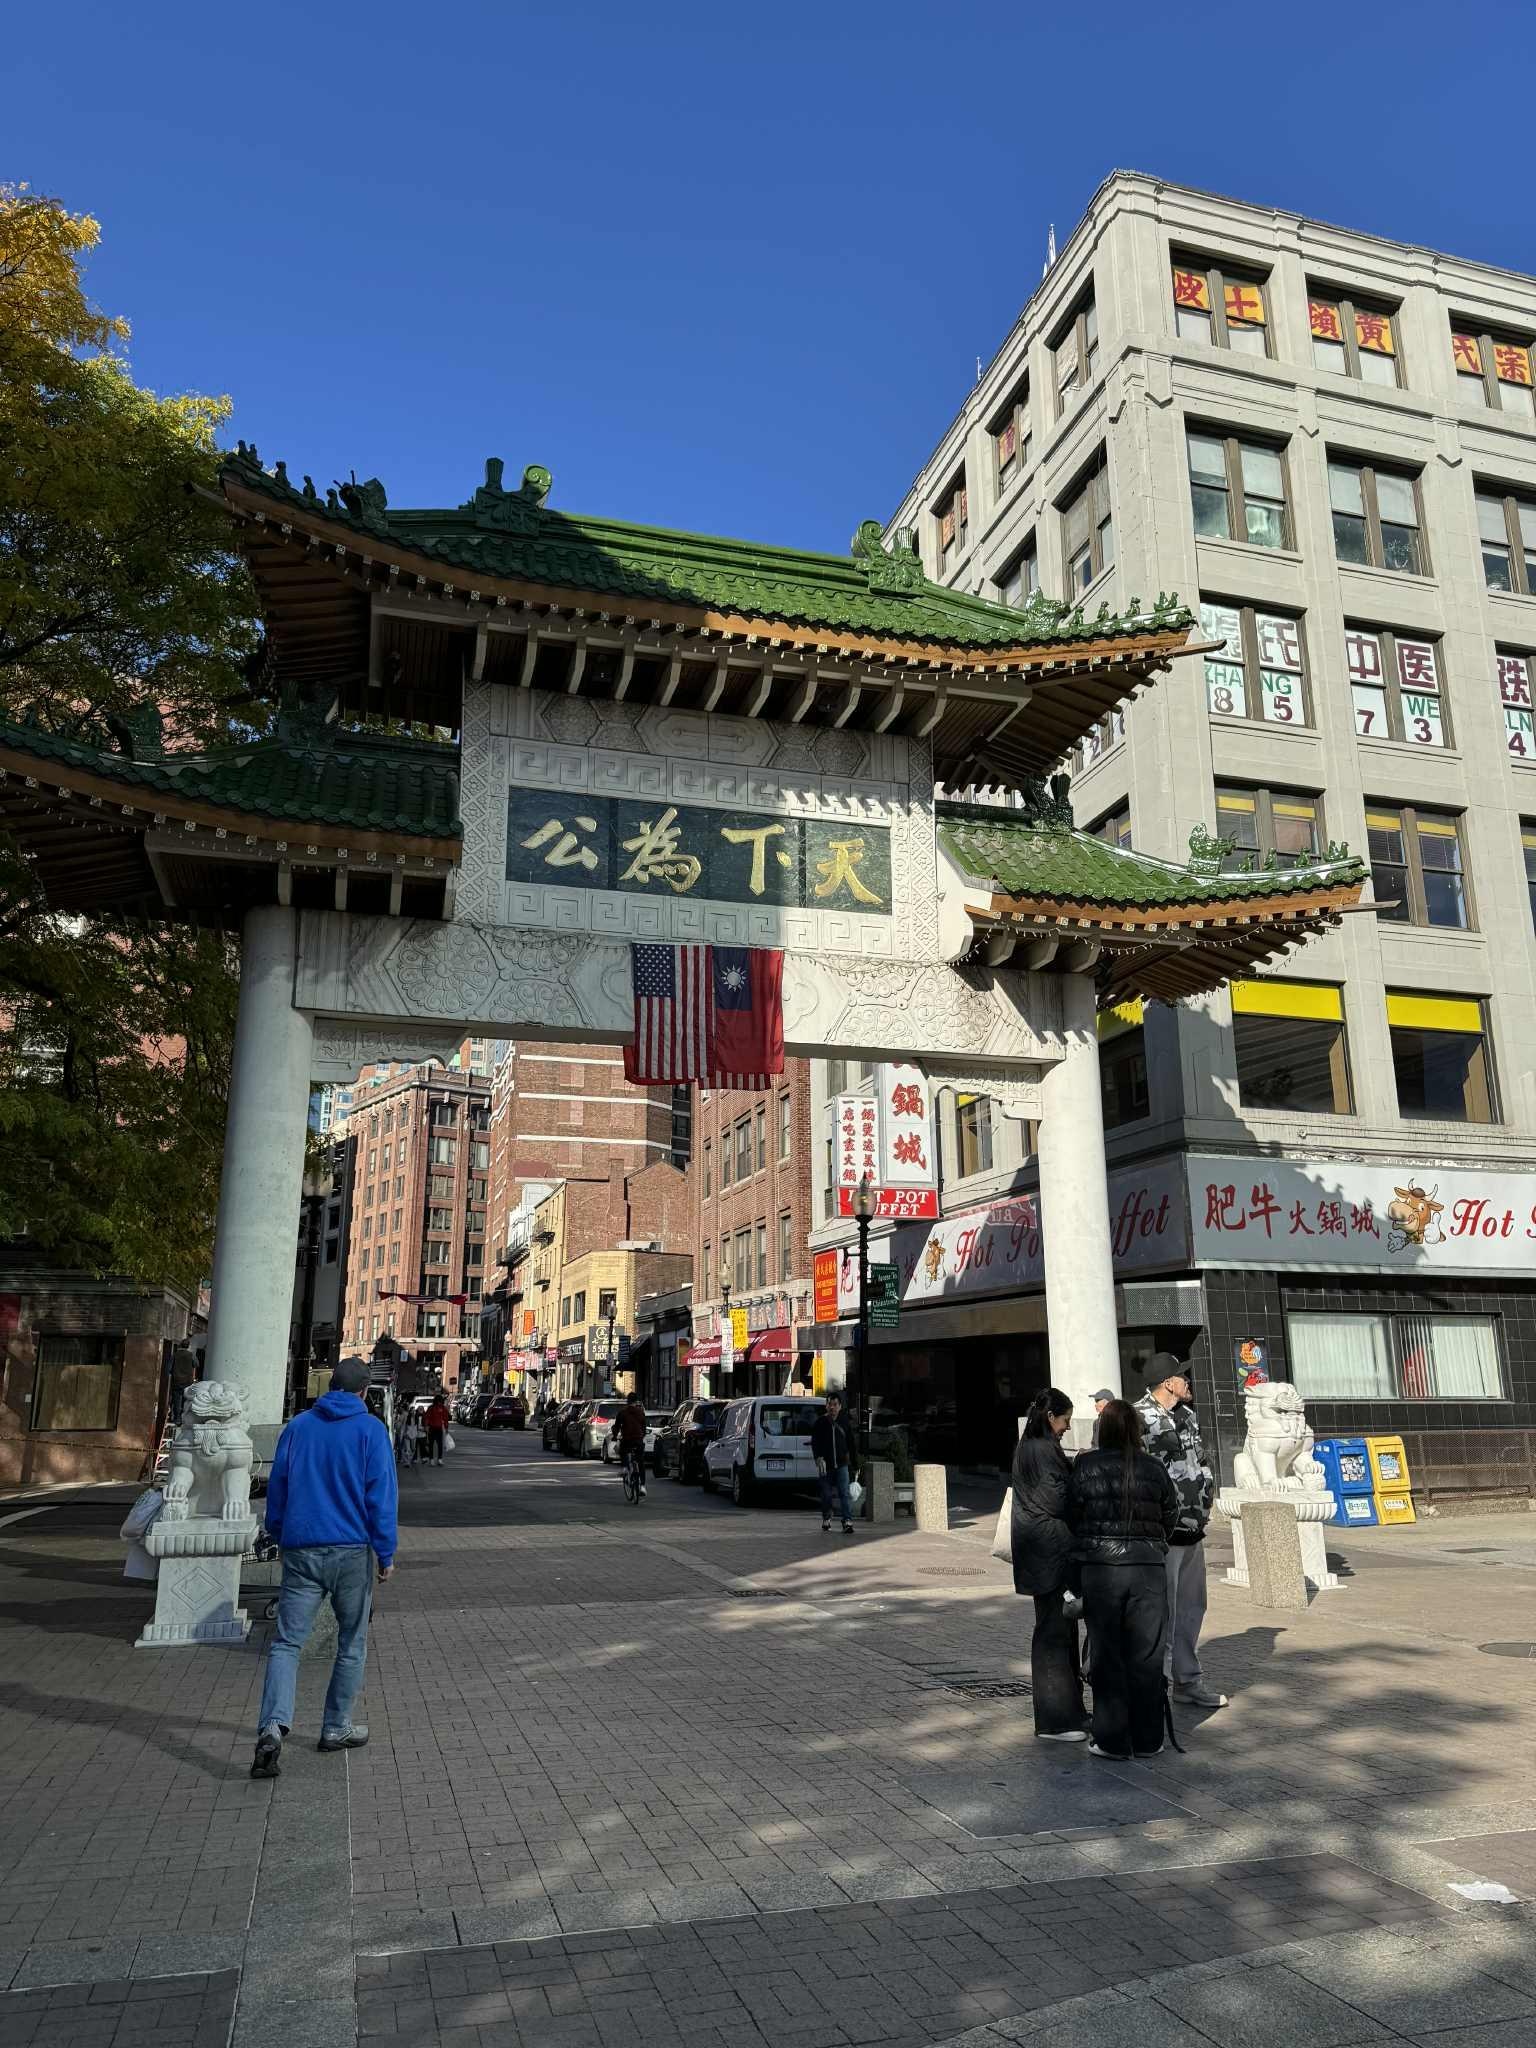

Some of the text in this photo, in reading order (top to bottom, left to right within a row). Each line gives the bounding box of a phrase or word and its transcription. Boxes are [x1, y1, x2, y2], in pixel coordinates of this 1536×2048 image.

[1214, 686, 1527, 756] 8 5 7 3 4
[891, 1063, 927, 1170] 鍋城
[874, 1202, 921, 1216] FFET
[894, 1190, 929, 1204] POT
[1204, 1182, 1380, 1240] 肥牛火鍋城
[1450, 1198, 1515, 1239] Hot
[954, 1188, 1171, 1274] Hot Po ffet
